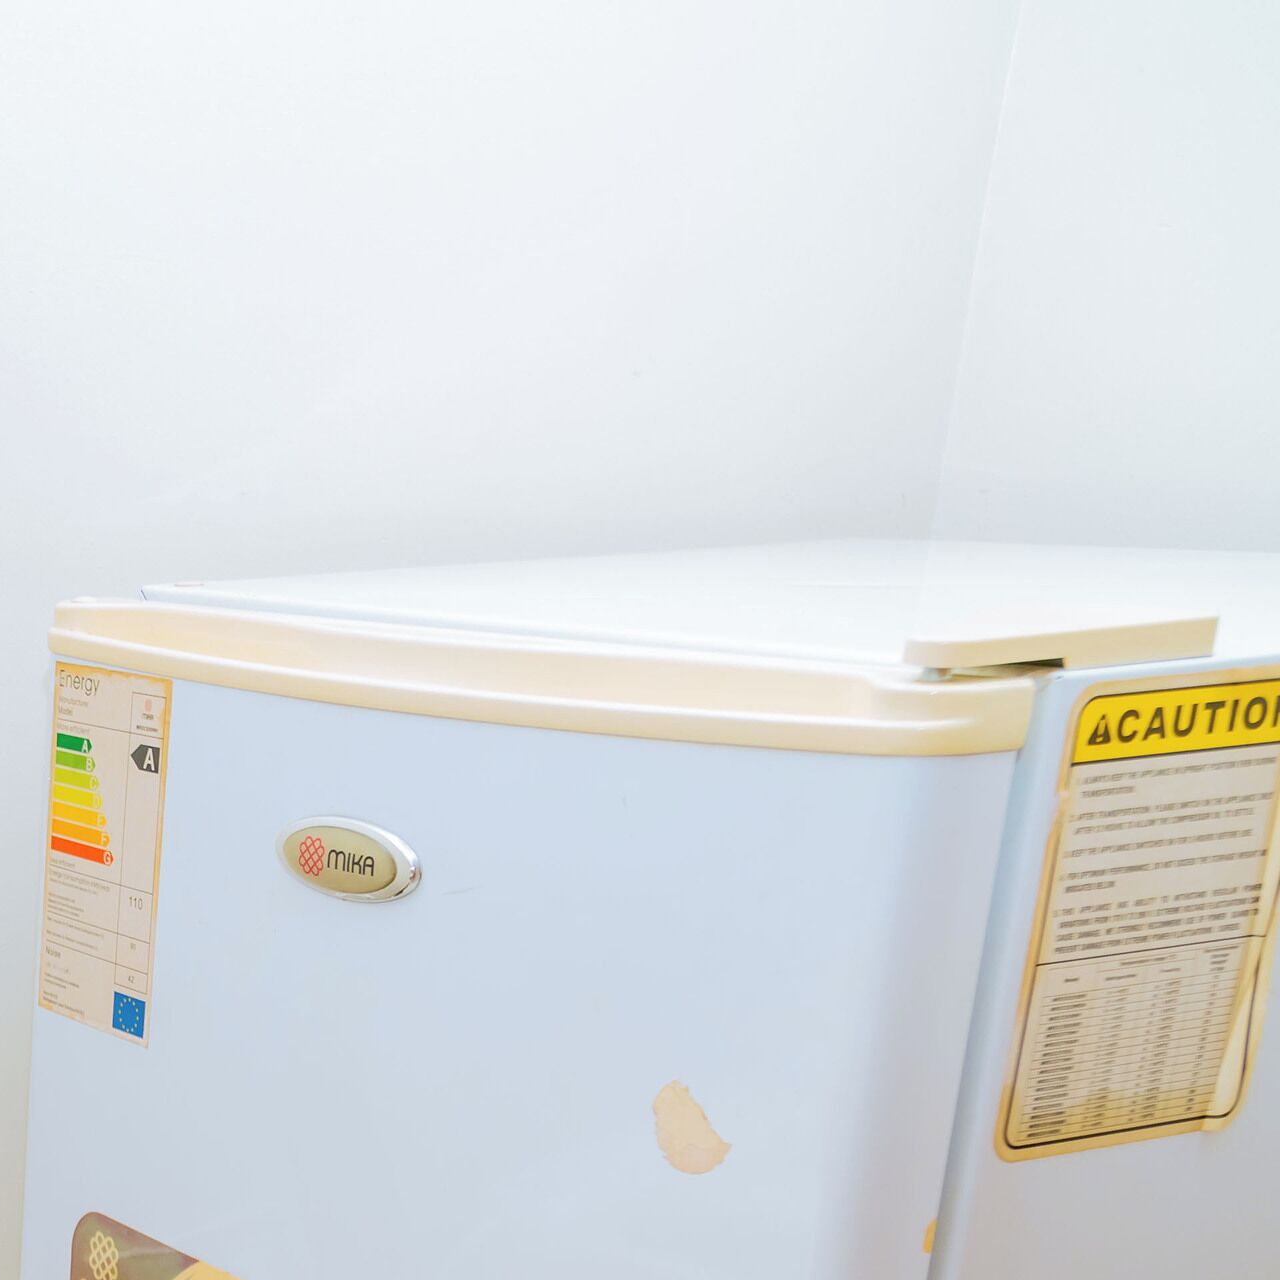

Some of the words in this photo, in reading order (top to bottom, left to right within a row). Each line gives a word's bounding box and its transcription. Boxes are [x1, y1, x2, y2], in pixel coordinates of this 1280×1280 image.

[59, 669, 100, 696] Energy
[1116, 696, 1280, 743] CAUTIO
[81, 739, 89, 753] A
[86, 758, 93, 772] B
[143, 747, 155, 772] A
[89, 776, 98, 791] C
[97, 814, 105, 827] E
[101, 832, 109, 847] F
[103, 851, 112, 865] G
[327, 849, 375, 876] MIKA
[129, 896, 143, 910] 110
